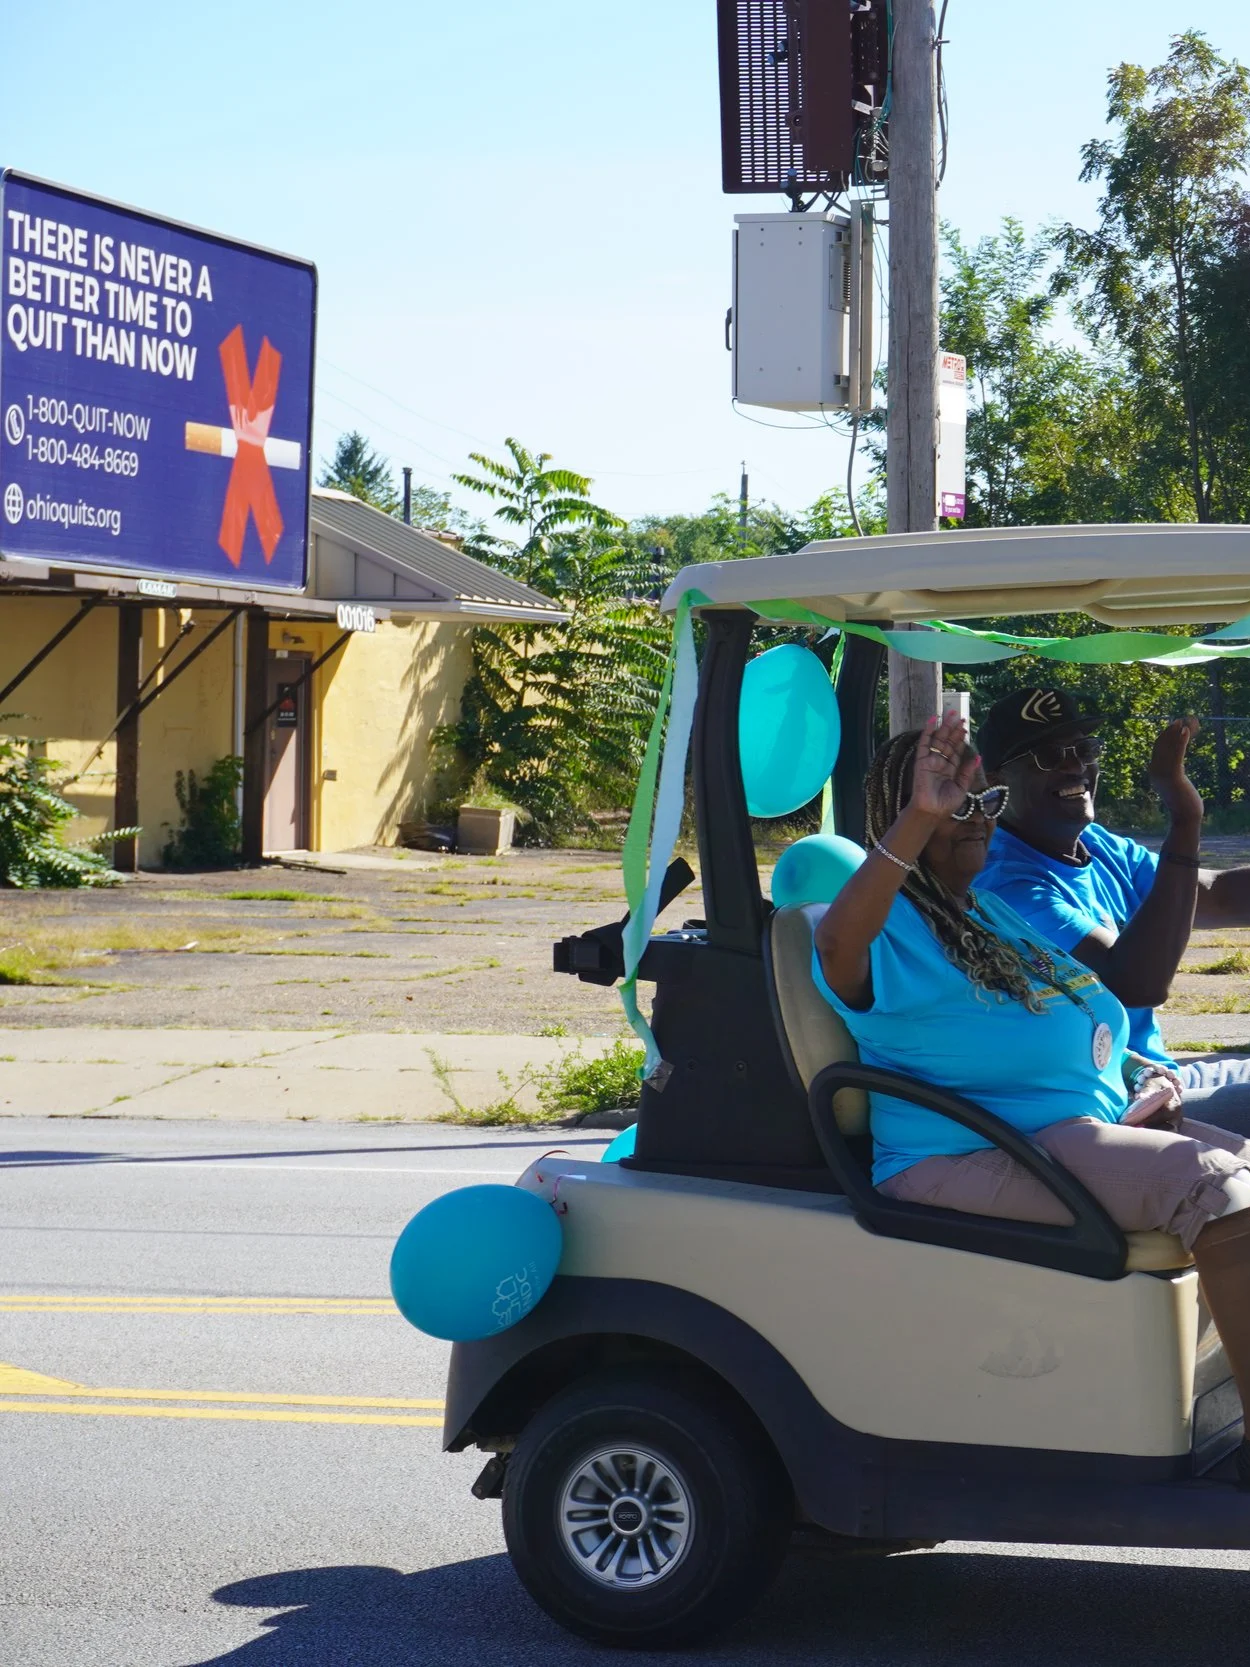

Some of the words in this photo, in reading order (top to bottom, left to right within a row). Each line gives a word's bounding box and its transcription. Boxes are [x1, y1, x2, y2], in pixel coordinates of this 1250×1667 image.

[8, 210, 88, 268] THERE
[94, 234, 115, 274] IS
[120, 241, 193, 297] NEVER
[196, 265, 213, 302] A
[8, 256, 100, 315] BETTER
[105, 281, 158, 330] TIME
[162, 296, 193, 338] TO
[7, 303, 68, 352] QUIT
[72, 317, 136, 368] THAN
[141, 334, 198, 381] NOW
[27, 394, 151, 442] 1-800-QUIT-NOW
[26, 434, 140, 477] 1-800-484-8669
[26, 493, 122, 536] ohioquits.org
[337, 604, 375, 632] 001016
